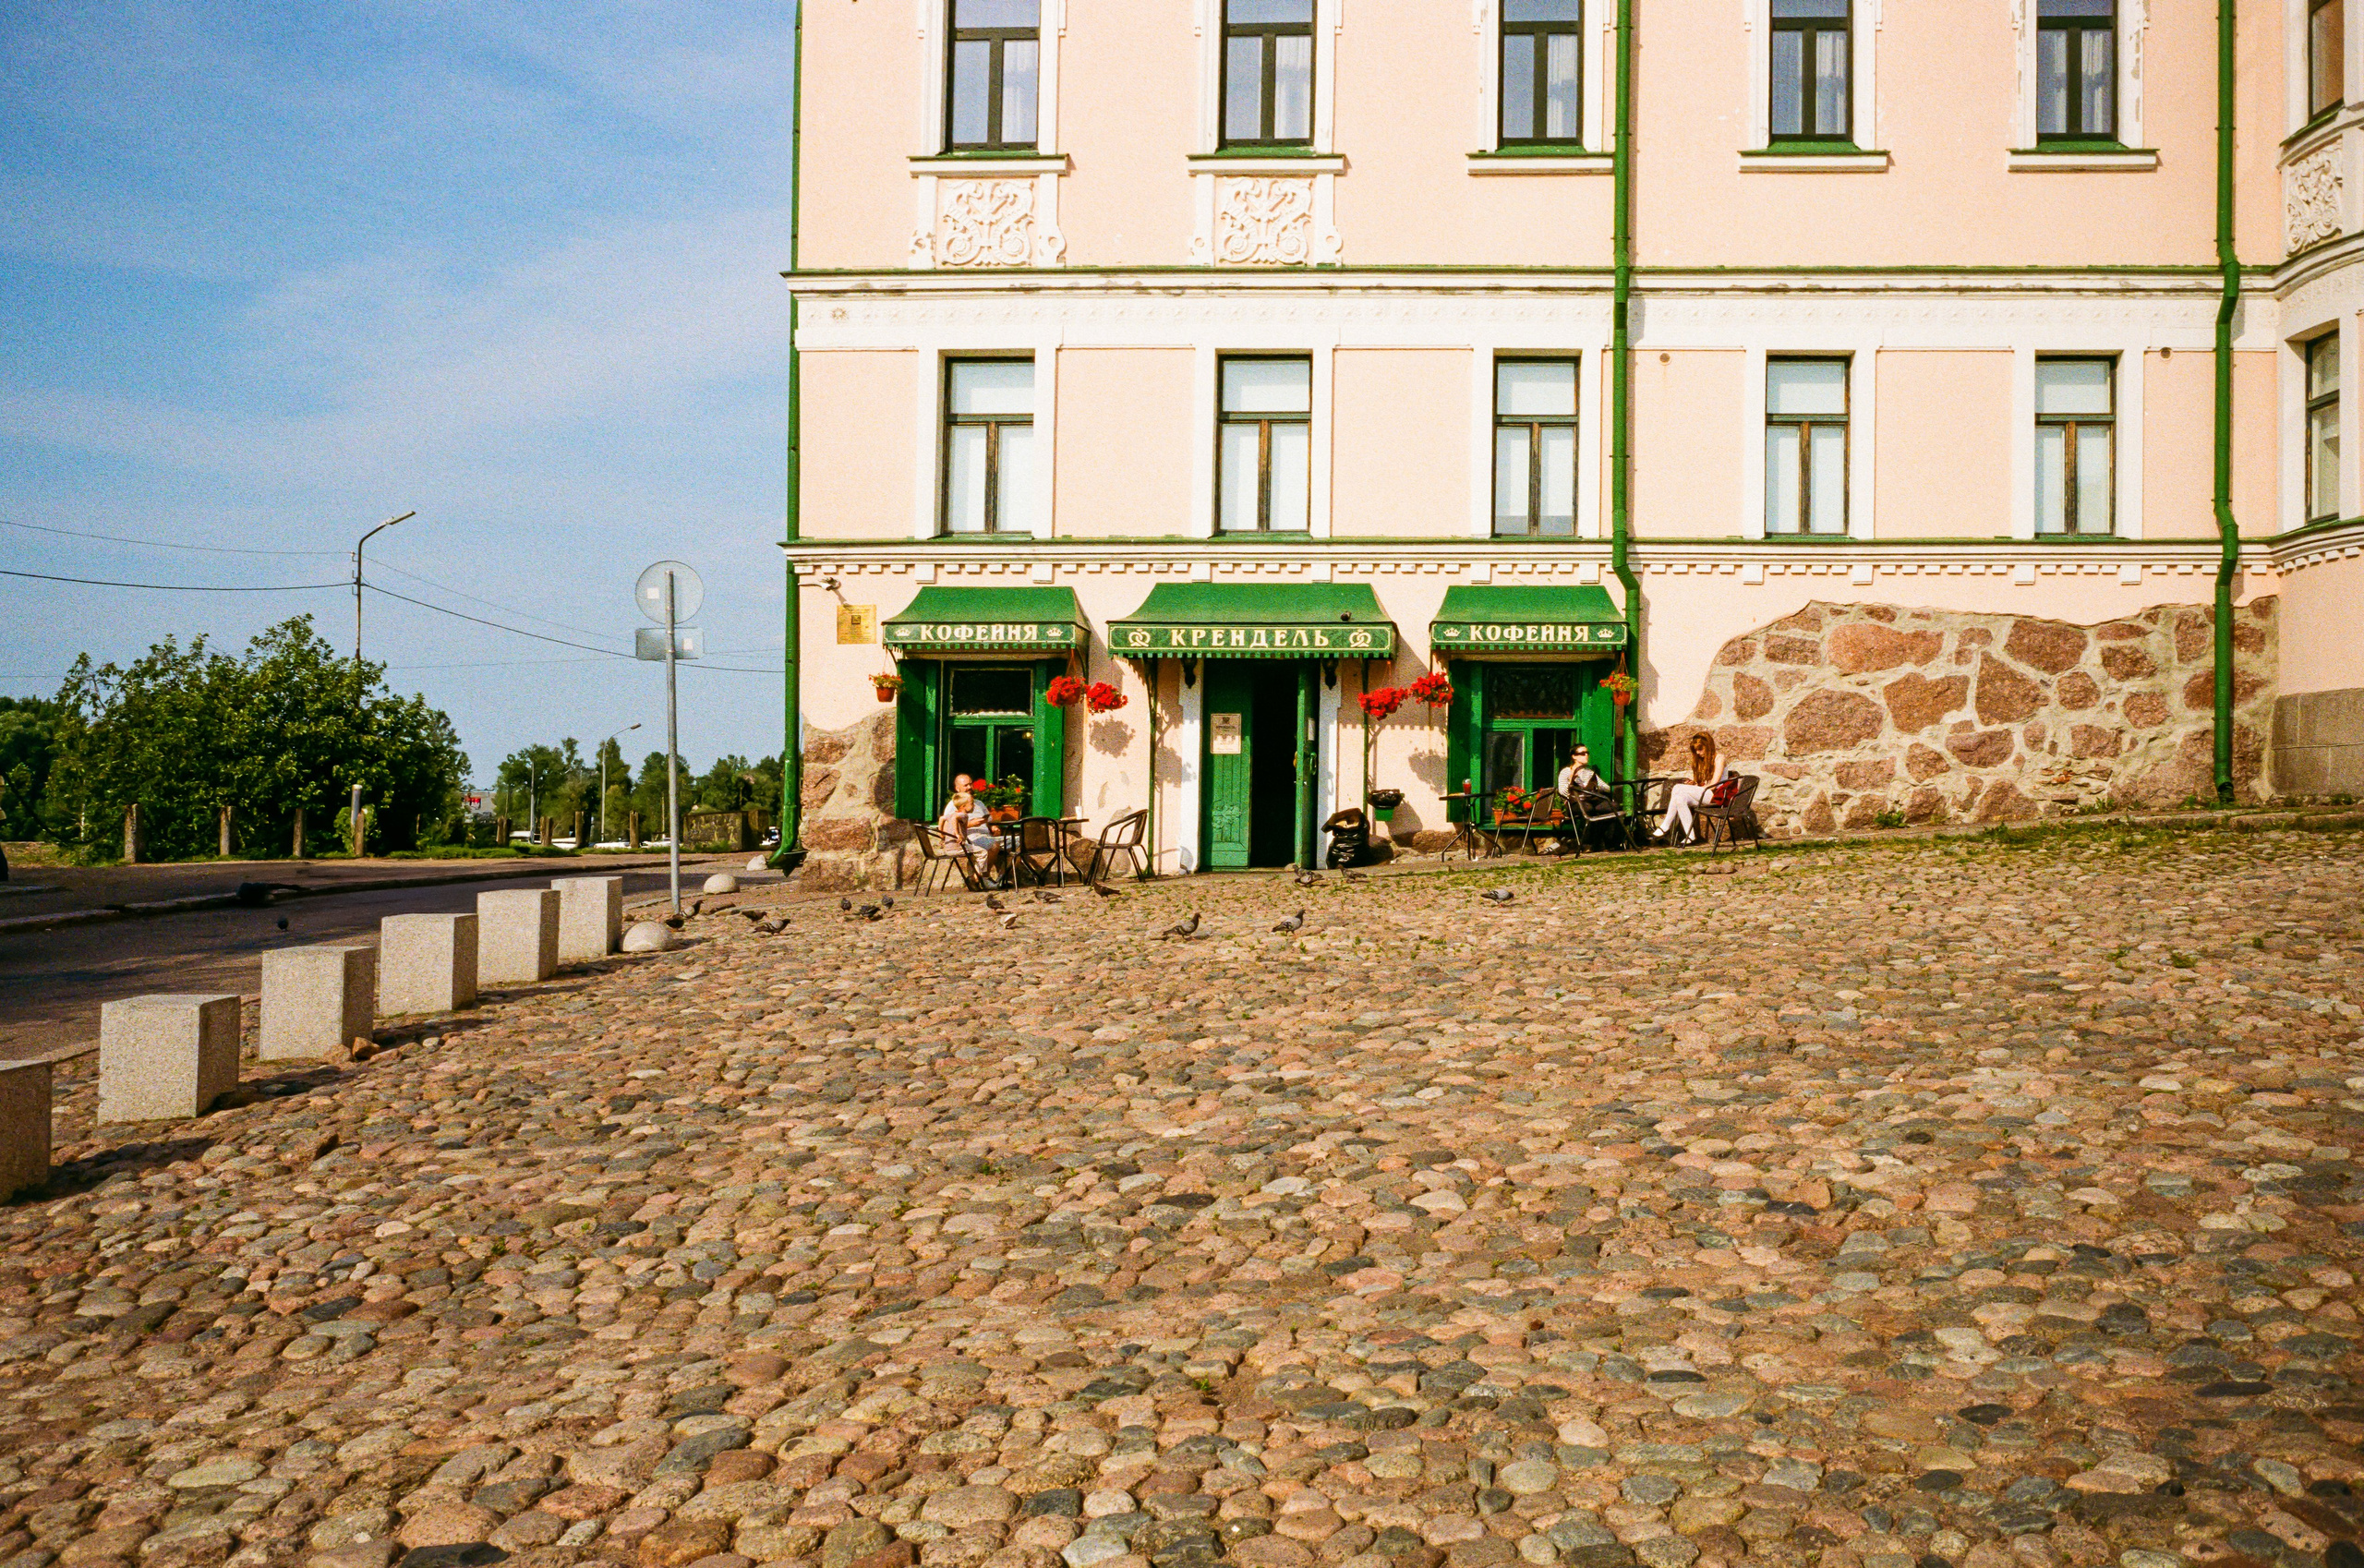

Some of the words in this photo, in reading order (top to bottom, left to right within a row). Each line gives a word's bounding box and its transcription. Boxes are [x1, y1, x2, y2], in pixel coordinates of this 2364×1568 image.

[920, 623, 1038, 641] КОФЕЙНЯ
[1171, 629, 1330, 648] КРЕНДЕЛЬ
[1469, 623, 1589, 642] КОФЕЙНЯ
